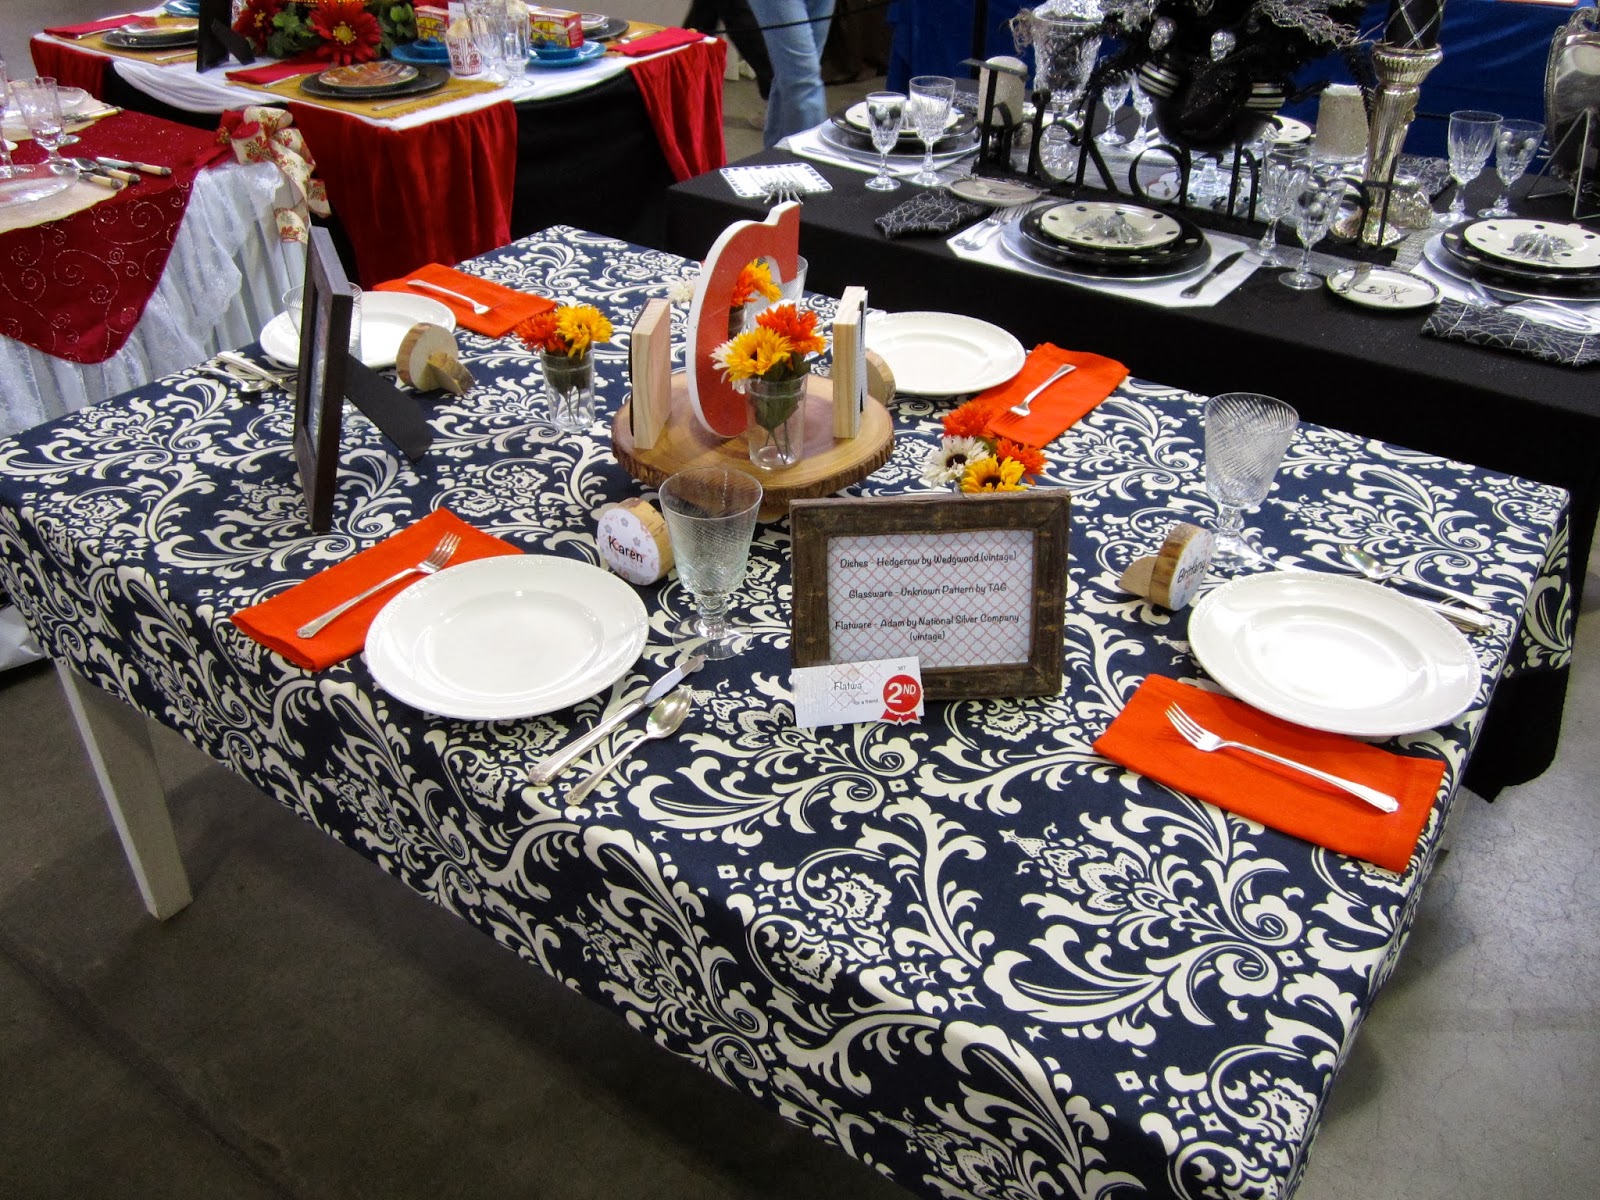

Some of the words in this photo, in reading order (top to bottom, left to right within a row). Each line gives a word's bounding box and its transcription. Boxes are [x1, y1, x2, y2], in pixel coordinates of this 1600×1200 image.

[608, 535, 643, 563] Karen
[840, 558, 869, 569] Dishes
[877, 557, 920, 569] Hedgerow
[921, 554, 932, 567] by
[933, 553, 979, 566] Wedgwood
[980, 550, 1017, 564] (vintage)
[848, 589, 893, 599] Glassware
[900, 586, 941, 597] Unknown
[942, 585, 974, 595] Pattern
[975, 584, 986, 596] by
[988, 582, 1007, 592] TAG
[835, 620, 872, 630] Flatware
[880, 618, 905, 628] Adam
[906, 616, 917, 629] by
[918, 615, 954, 626] National
[955, 614, 978, 625] Silver
[980, 613, 1020, 625] Company
[909, 630, 946, 643] (vintage)
[886, 682, 917, 704] 2ND
